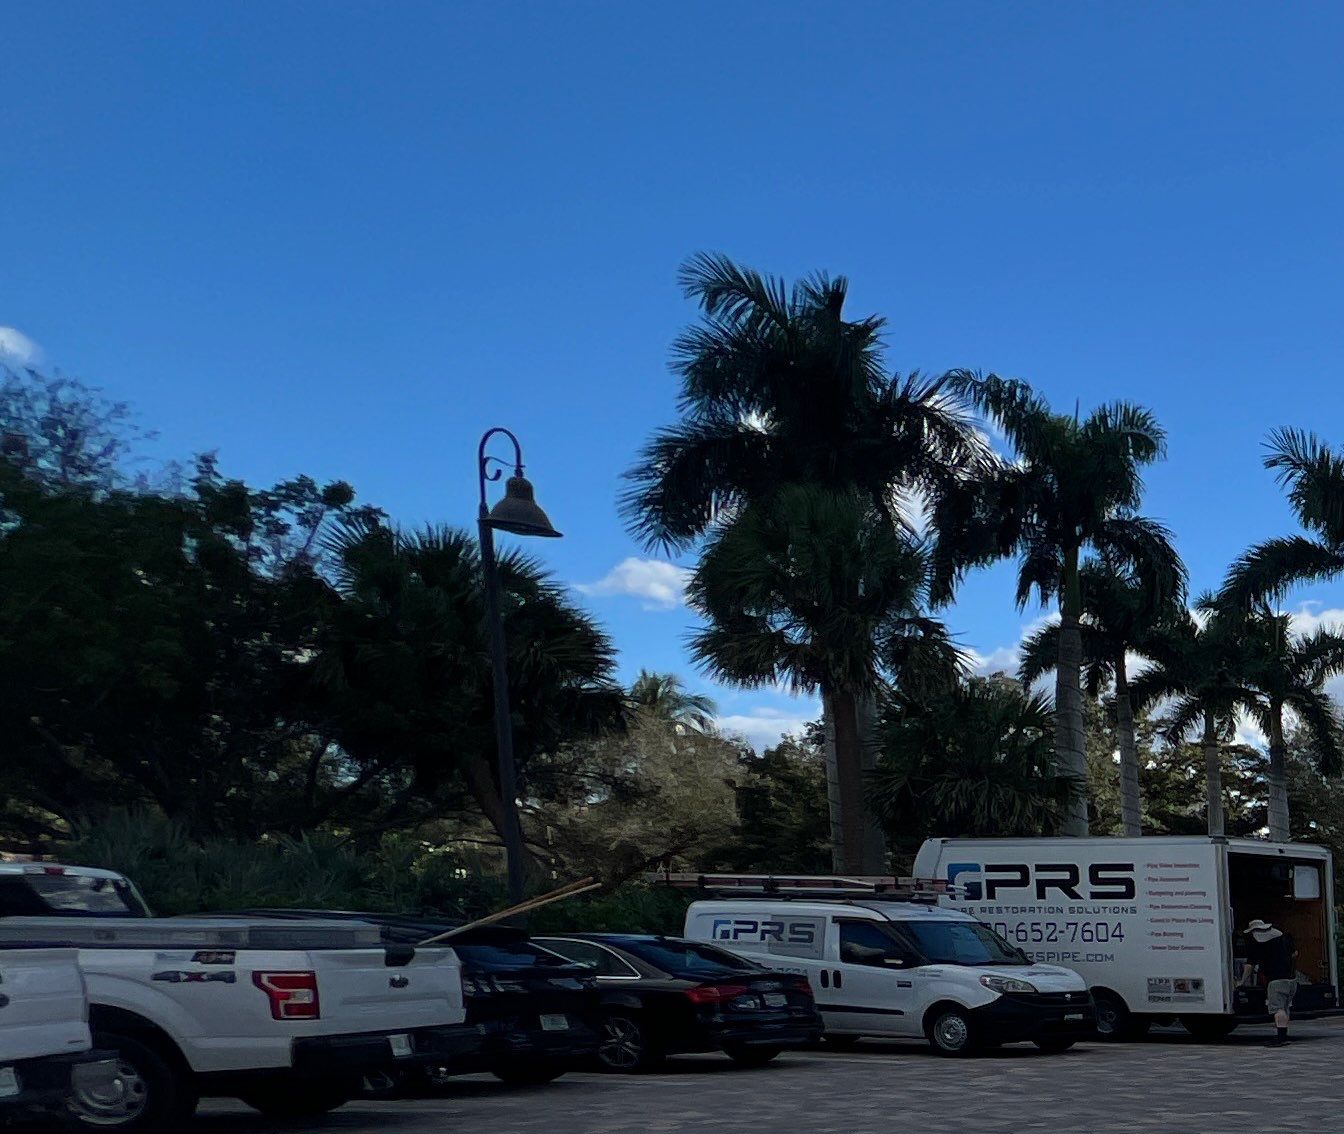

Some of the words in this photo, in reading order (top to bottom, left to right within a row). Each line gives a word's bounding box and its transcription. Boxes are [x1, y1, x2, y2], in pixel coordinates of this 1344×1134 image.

[980, 907, 1064, 915] RESTORATION
[1069, 907, 1137, 915] SOLUTIONS
[983, 921, 1125, 943] 0-652-7604
[1026, 951, 1115, 963] RSPIPE.COM
